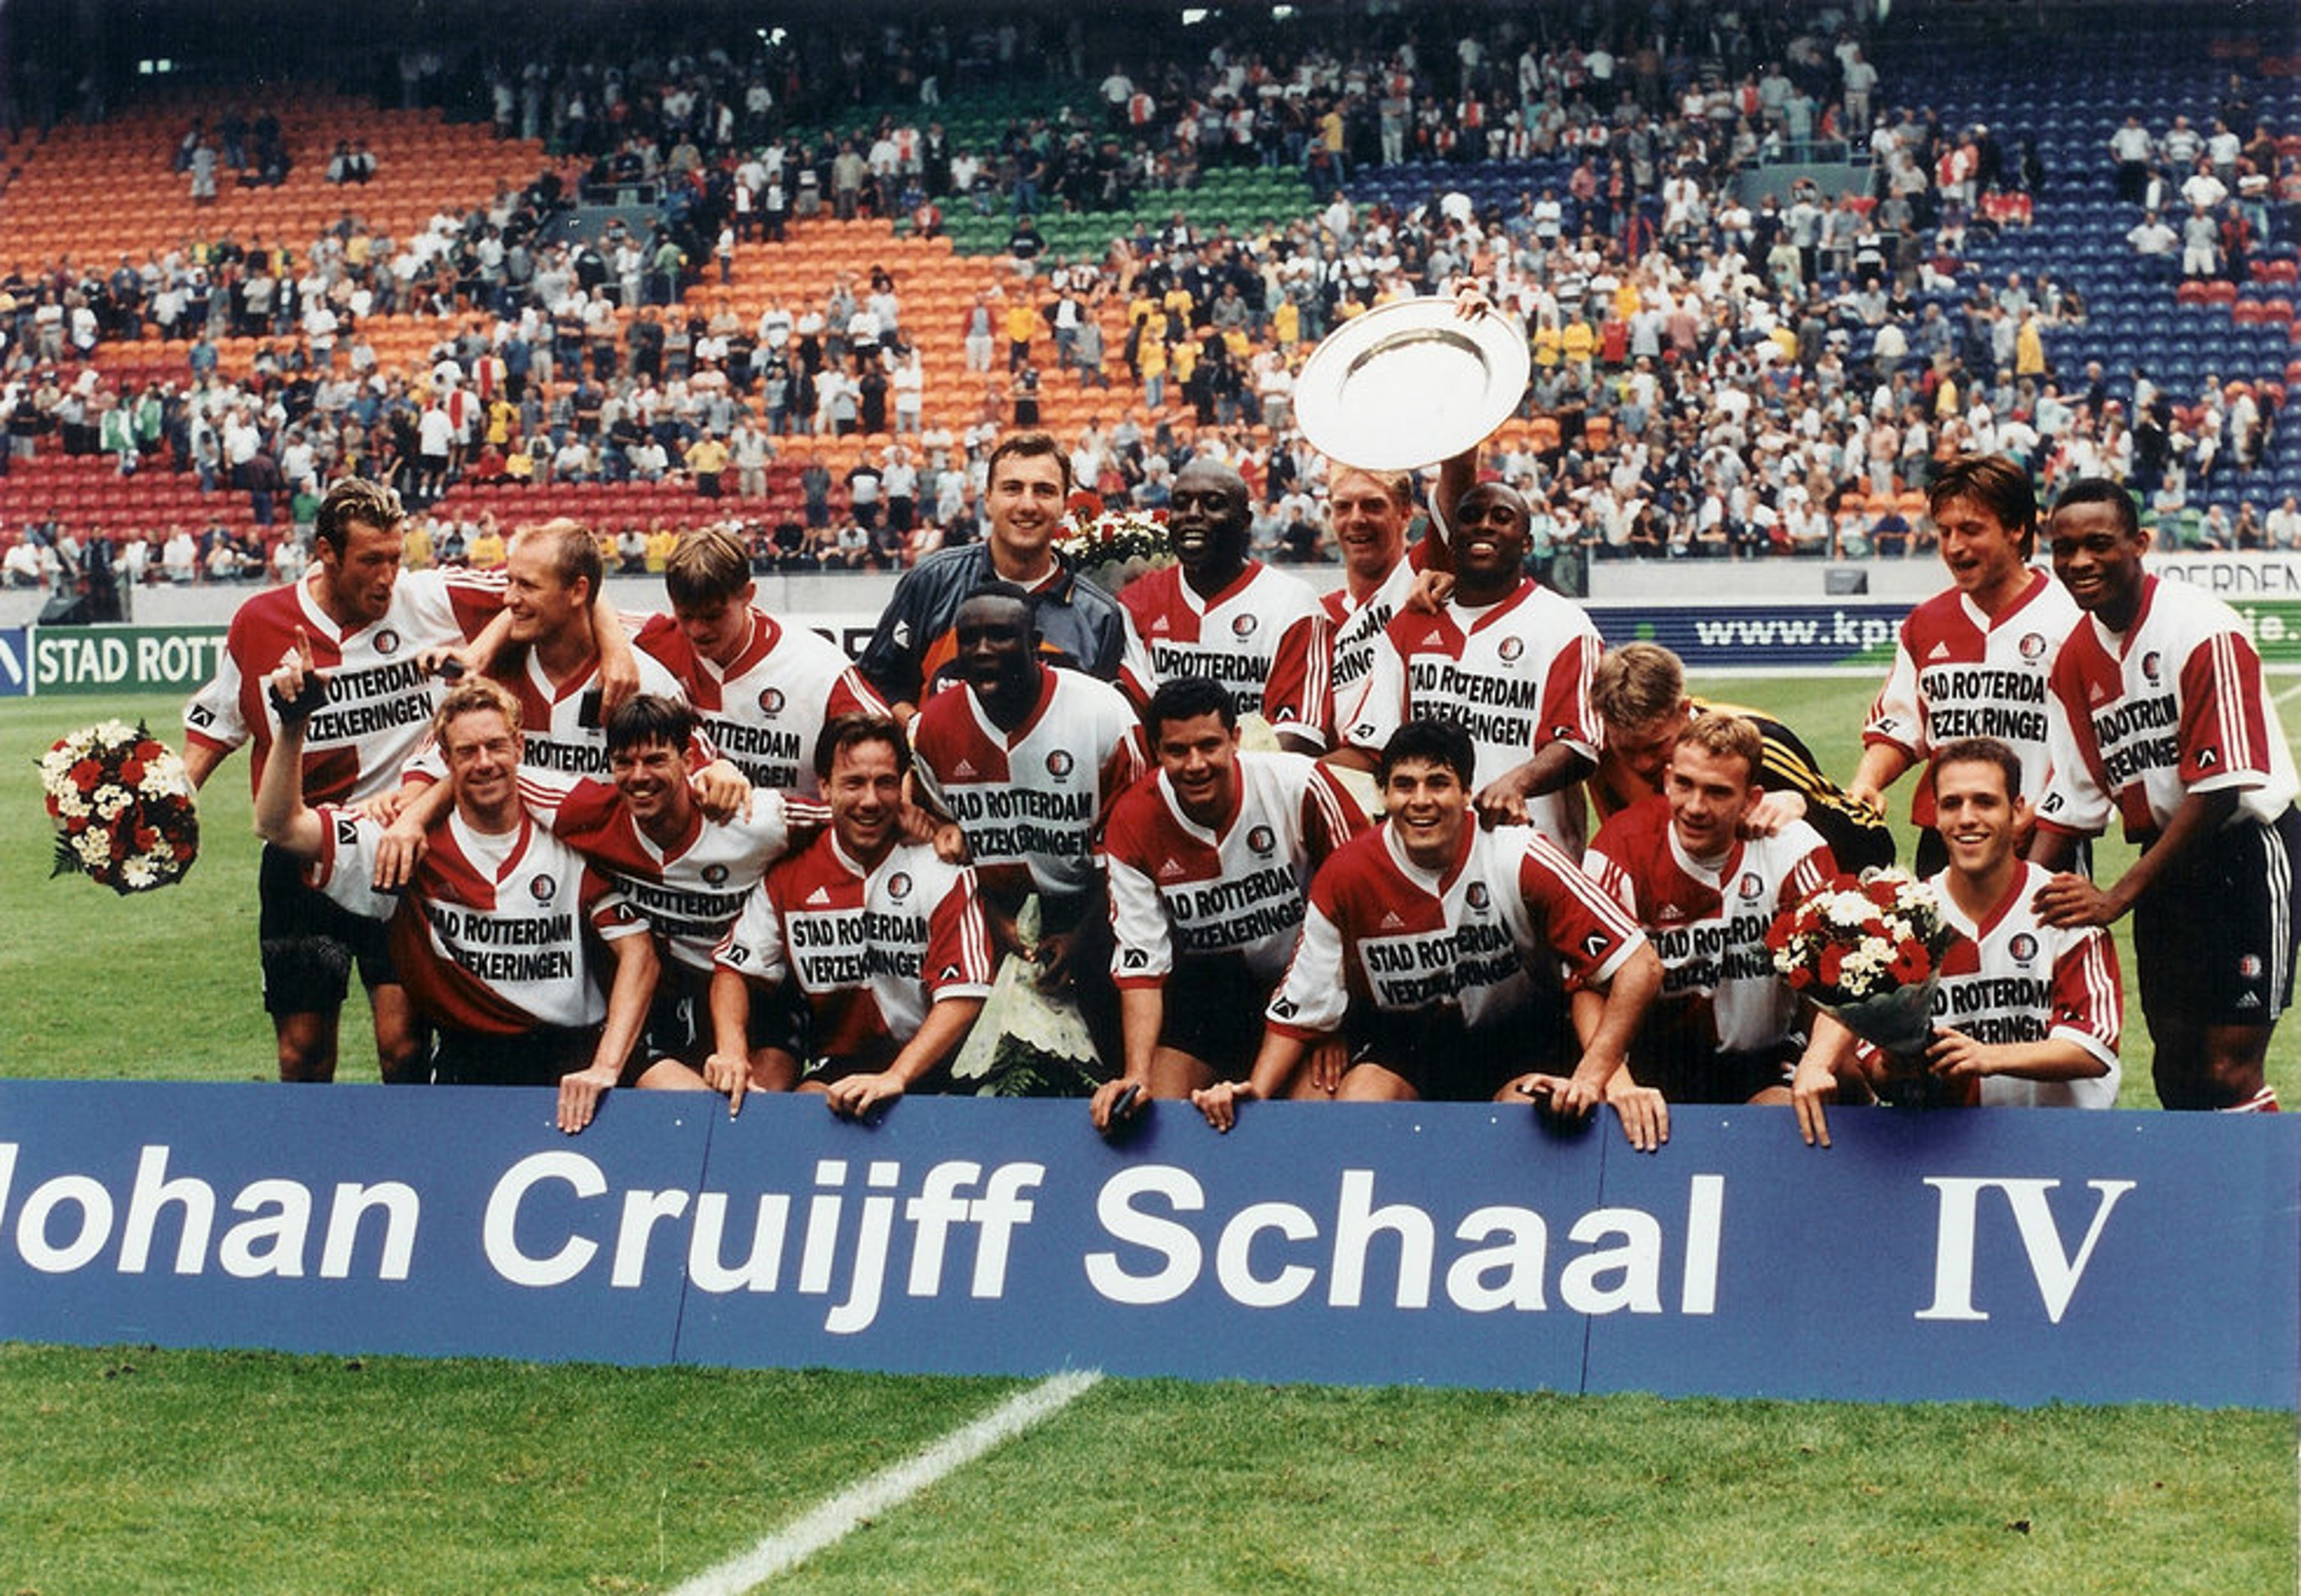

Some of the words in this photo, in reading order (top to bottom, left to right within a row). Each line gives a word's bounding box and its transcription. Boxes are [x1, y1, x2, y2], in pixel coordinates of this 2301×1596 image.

[38, 638, 128, 684] STAD
[137, 636, 229, 682] ROTT
[306, 692, 435, 741] ZEKERINGEN
[986, 788, 1094, 823] ROTTERDAM
[1366, 944, 1414, 973] STAD
[483, 1150, 1046, 1334] Cruijff
[1084, 1164, 1725, 1314] Schaal
[1914, 1176, 2136, 1324] IV
